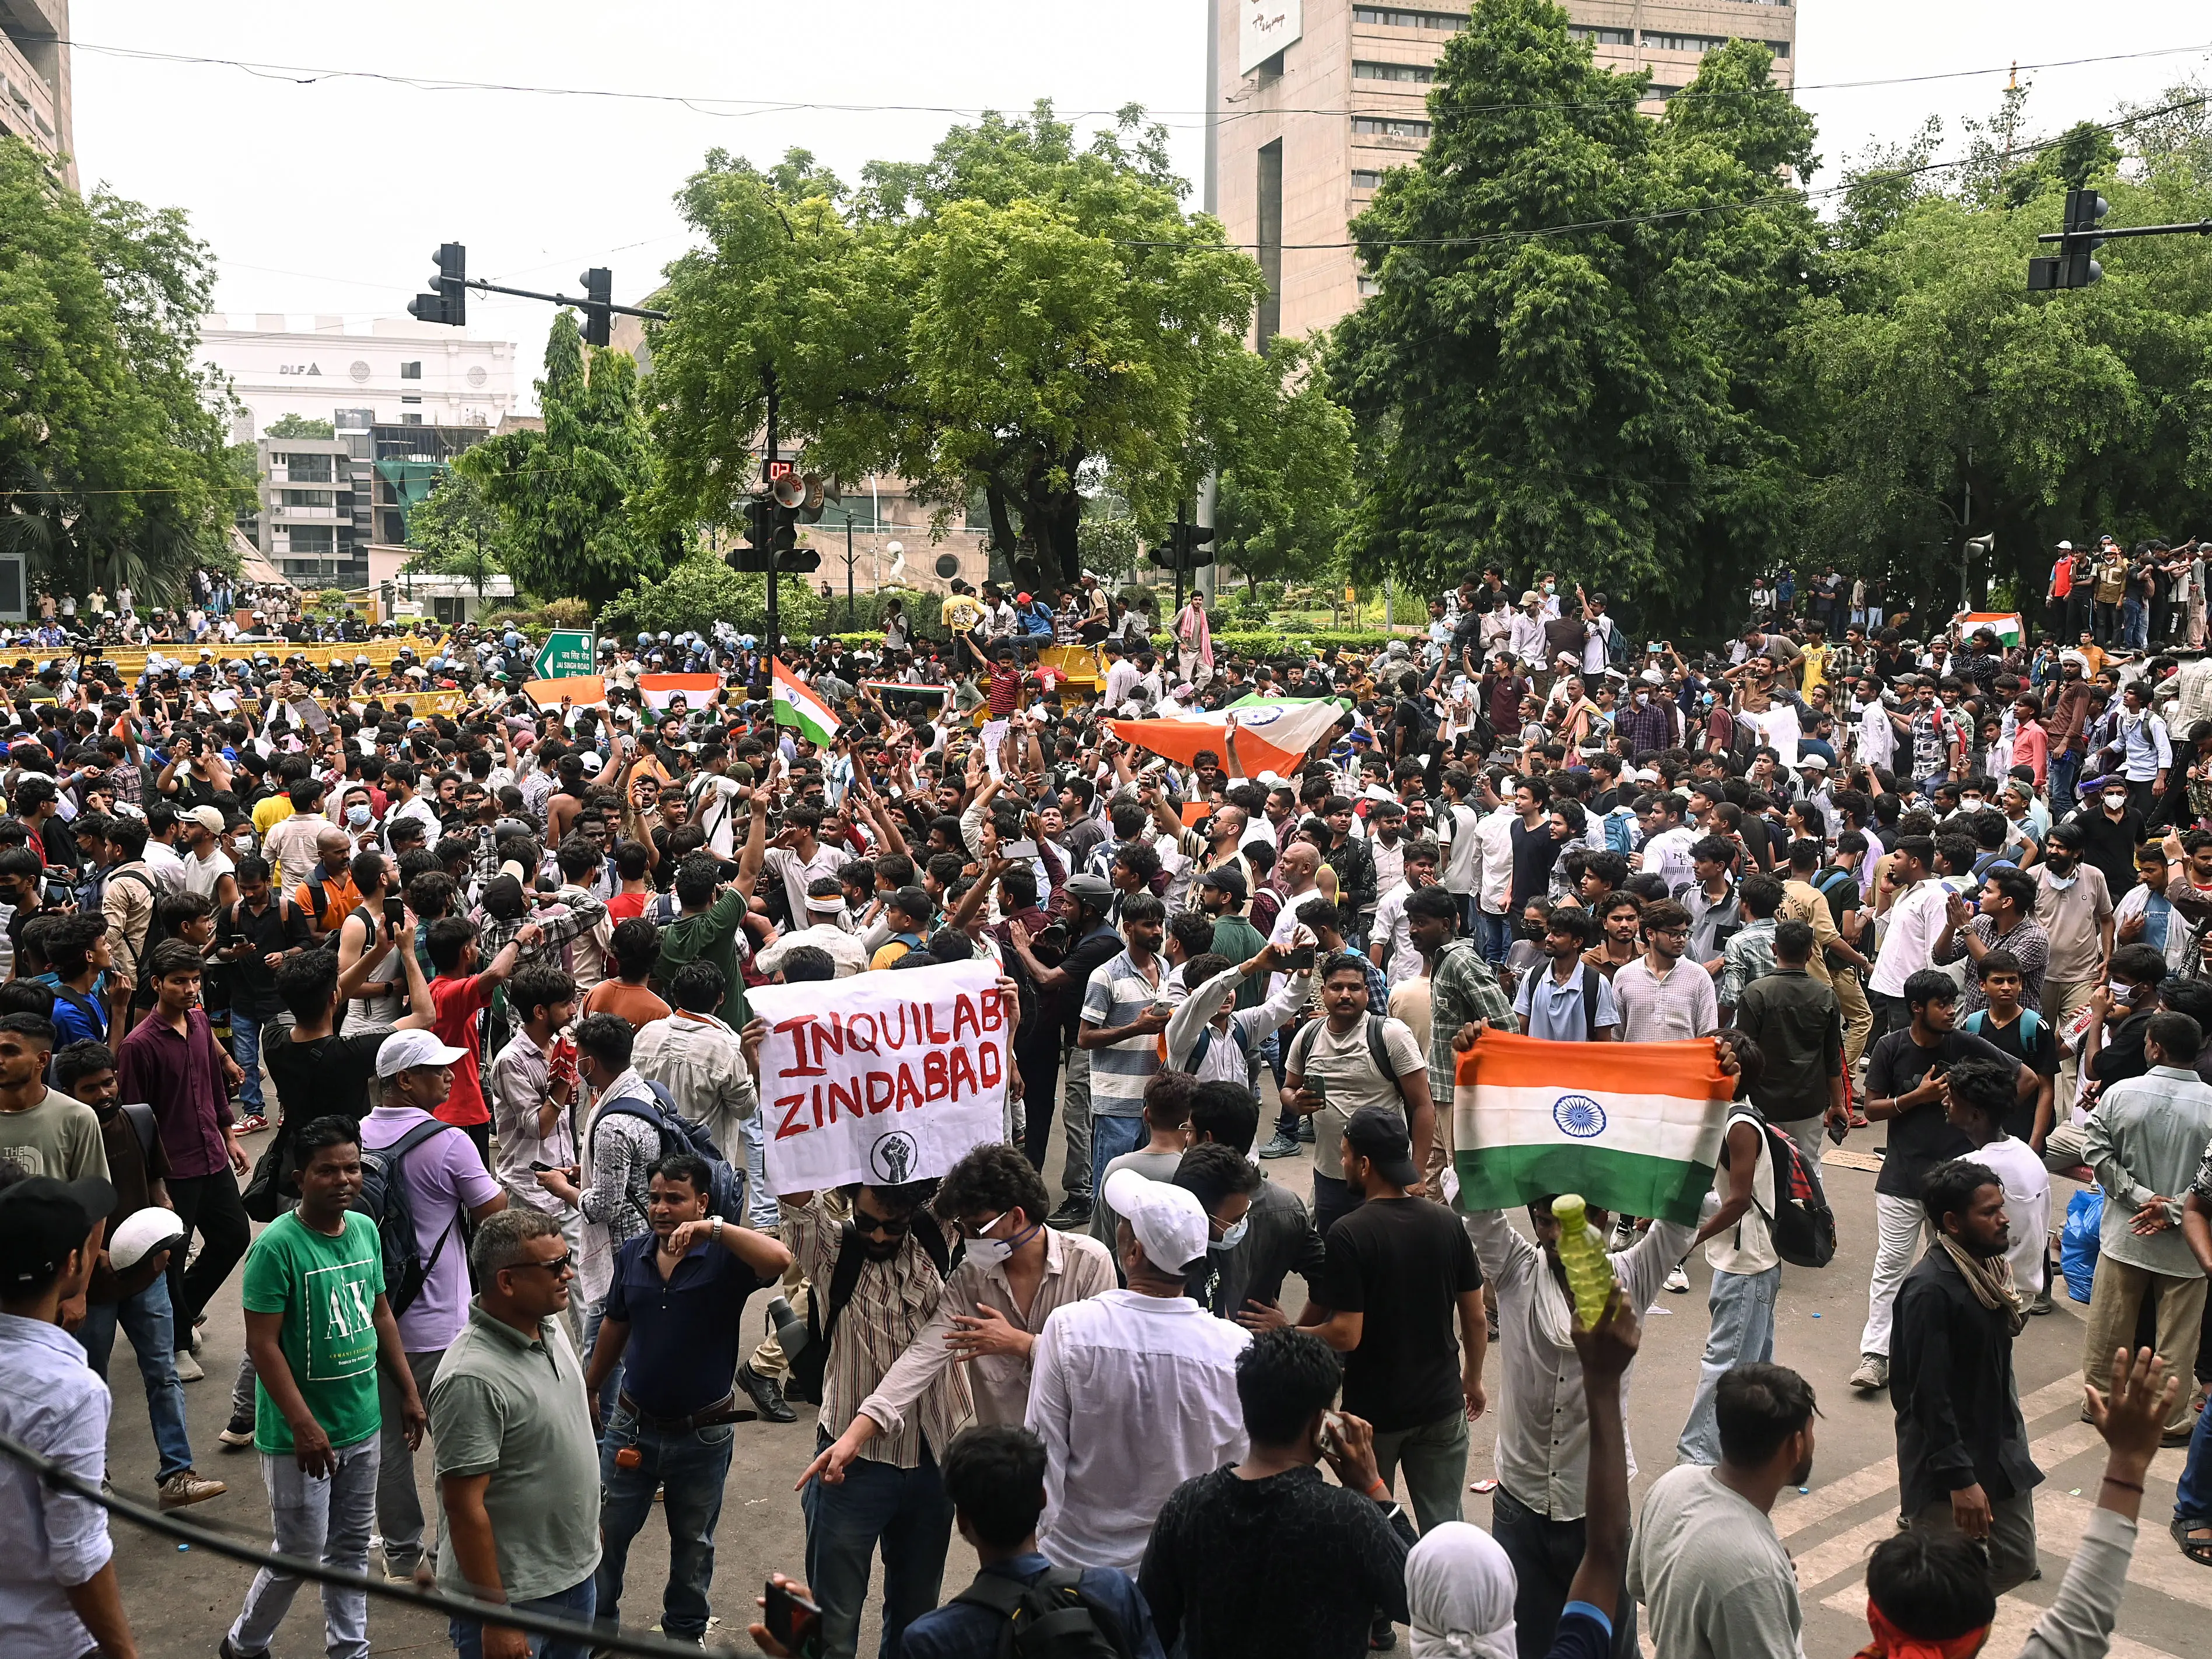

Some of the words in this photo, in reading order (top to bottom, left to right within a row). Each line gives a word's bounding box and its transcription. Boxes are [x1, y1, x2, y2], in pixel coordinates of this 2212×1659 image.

[279, 365, 305, 374] DLF
[571, 650, 580, 660] सिंह
[581, 650, 590, 660] रोड
[774, 988, 1002, 1077] INQUILAB
[774, 1042, 1002, 1142] ZINDABAD
[4, 1146, 23, 1156] THE
